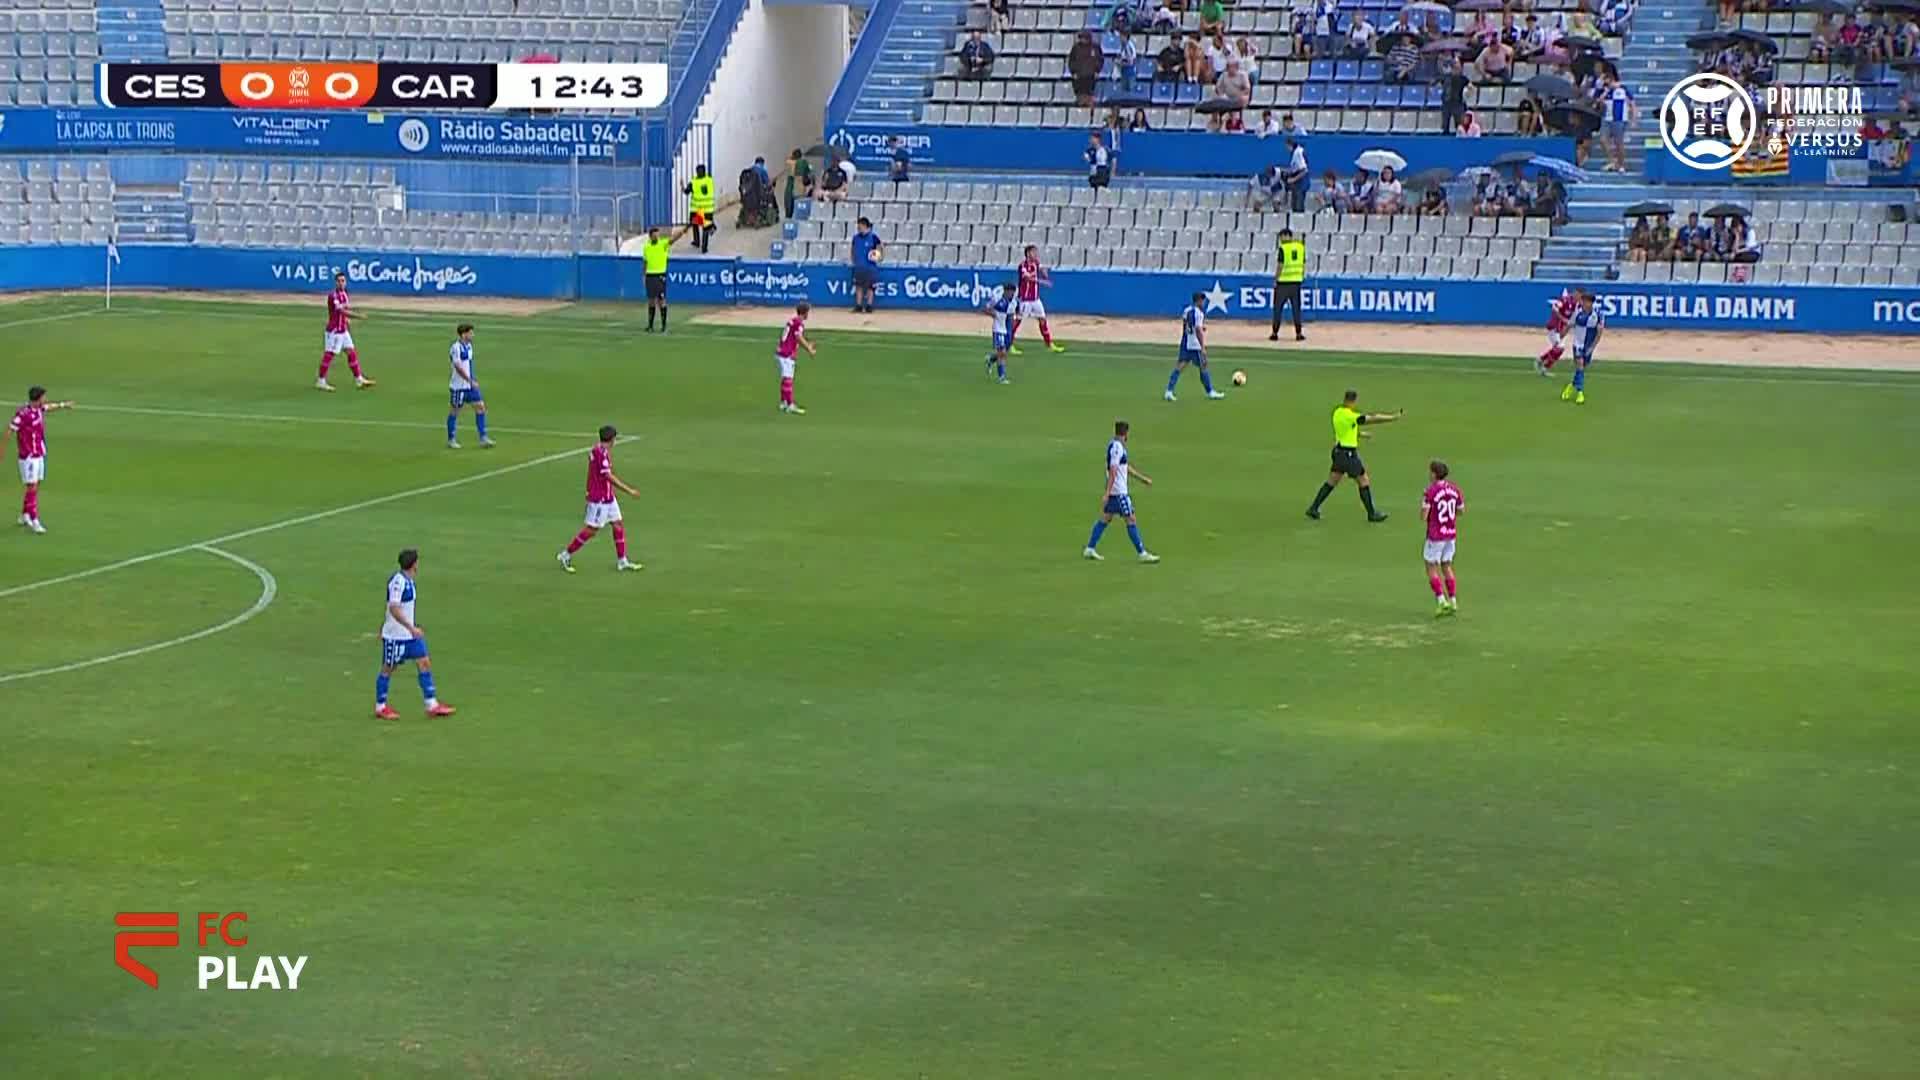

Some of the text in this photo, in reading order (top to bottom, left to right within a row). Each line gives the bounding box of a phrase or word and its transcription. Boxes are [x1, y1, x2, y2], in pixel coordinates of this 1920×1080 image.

[56, 121, 175, 140] LA CAPSA DE TRONS
[231, 115, 331, 131] VITALDENT
[500, 121, 586, 142] Sabadell
[591, 123, 629, 144] 94.6
[440, 141, 569, 157] www.radiosabadell.fm
[367, 260, 412, 283] Corte
[668, 271, 716, 286] VIAJES
[827, 279, 898, 297] VIES
[925, 276, 971, 299] Corte
[1240, 286, 1436, 313] ESTELLA DAMM
[1714, 297, 1796, 321] DAMM
[1437, 499, 1457, 523] 20
